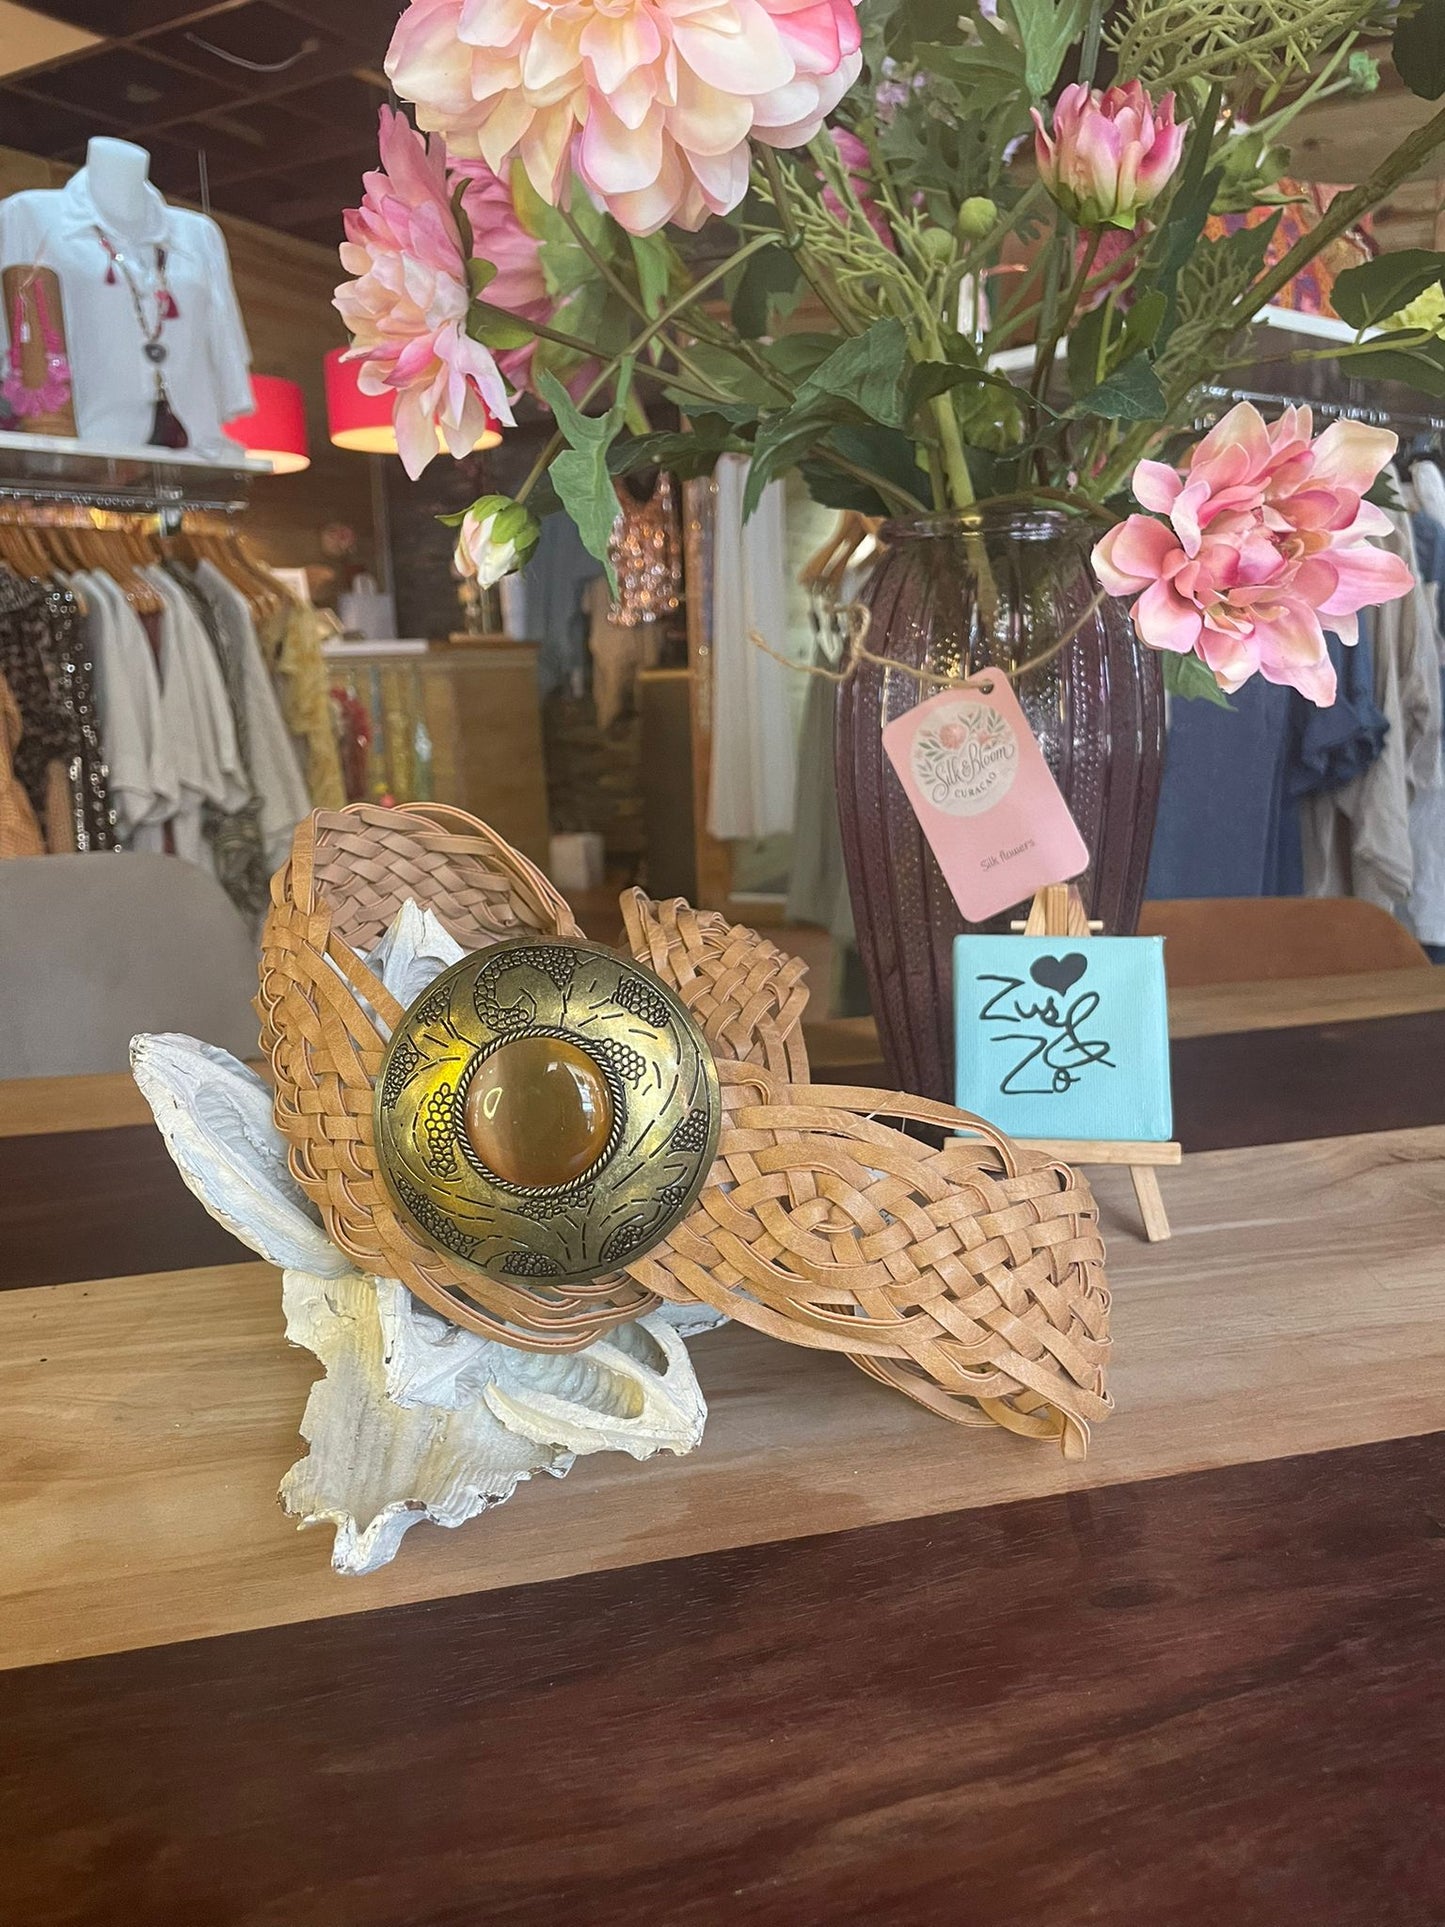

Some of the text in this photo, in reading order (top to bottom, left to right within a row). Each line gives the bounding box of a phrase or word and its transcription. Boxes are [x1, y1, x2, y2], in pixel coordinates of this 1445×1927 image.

[932, 755, 964, 804] Silk
[966, 742, 1015, 785] Bloom
[980, 839, 1035, 872] Silk flowers
[990, 1034, 1082, 1095] Zo
